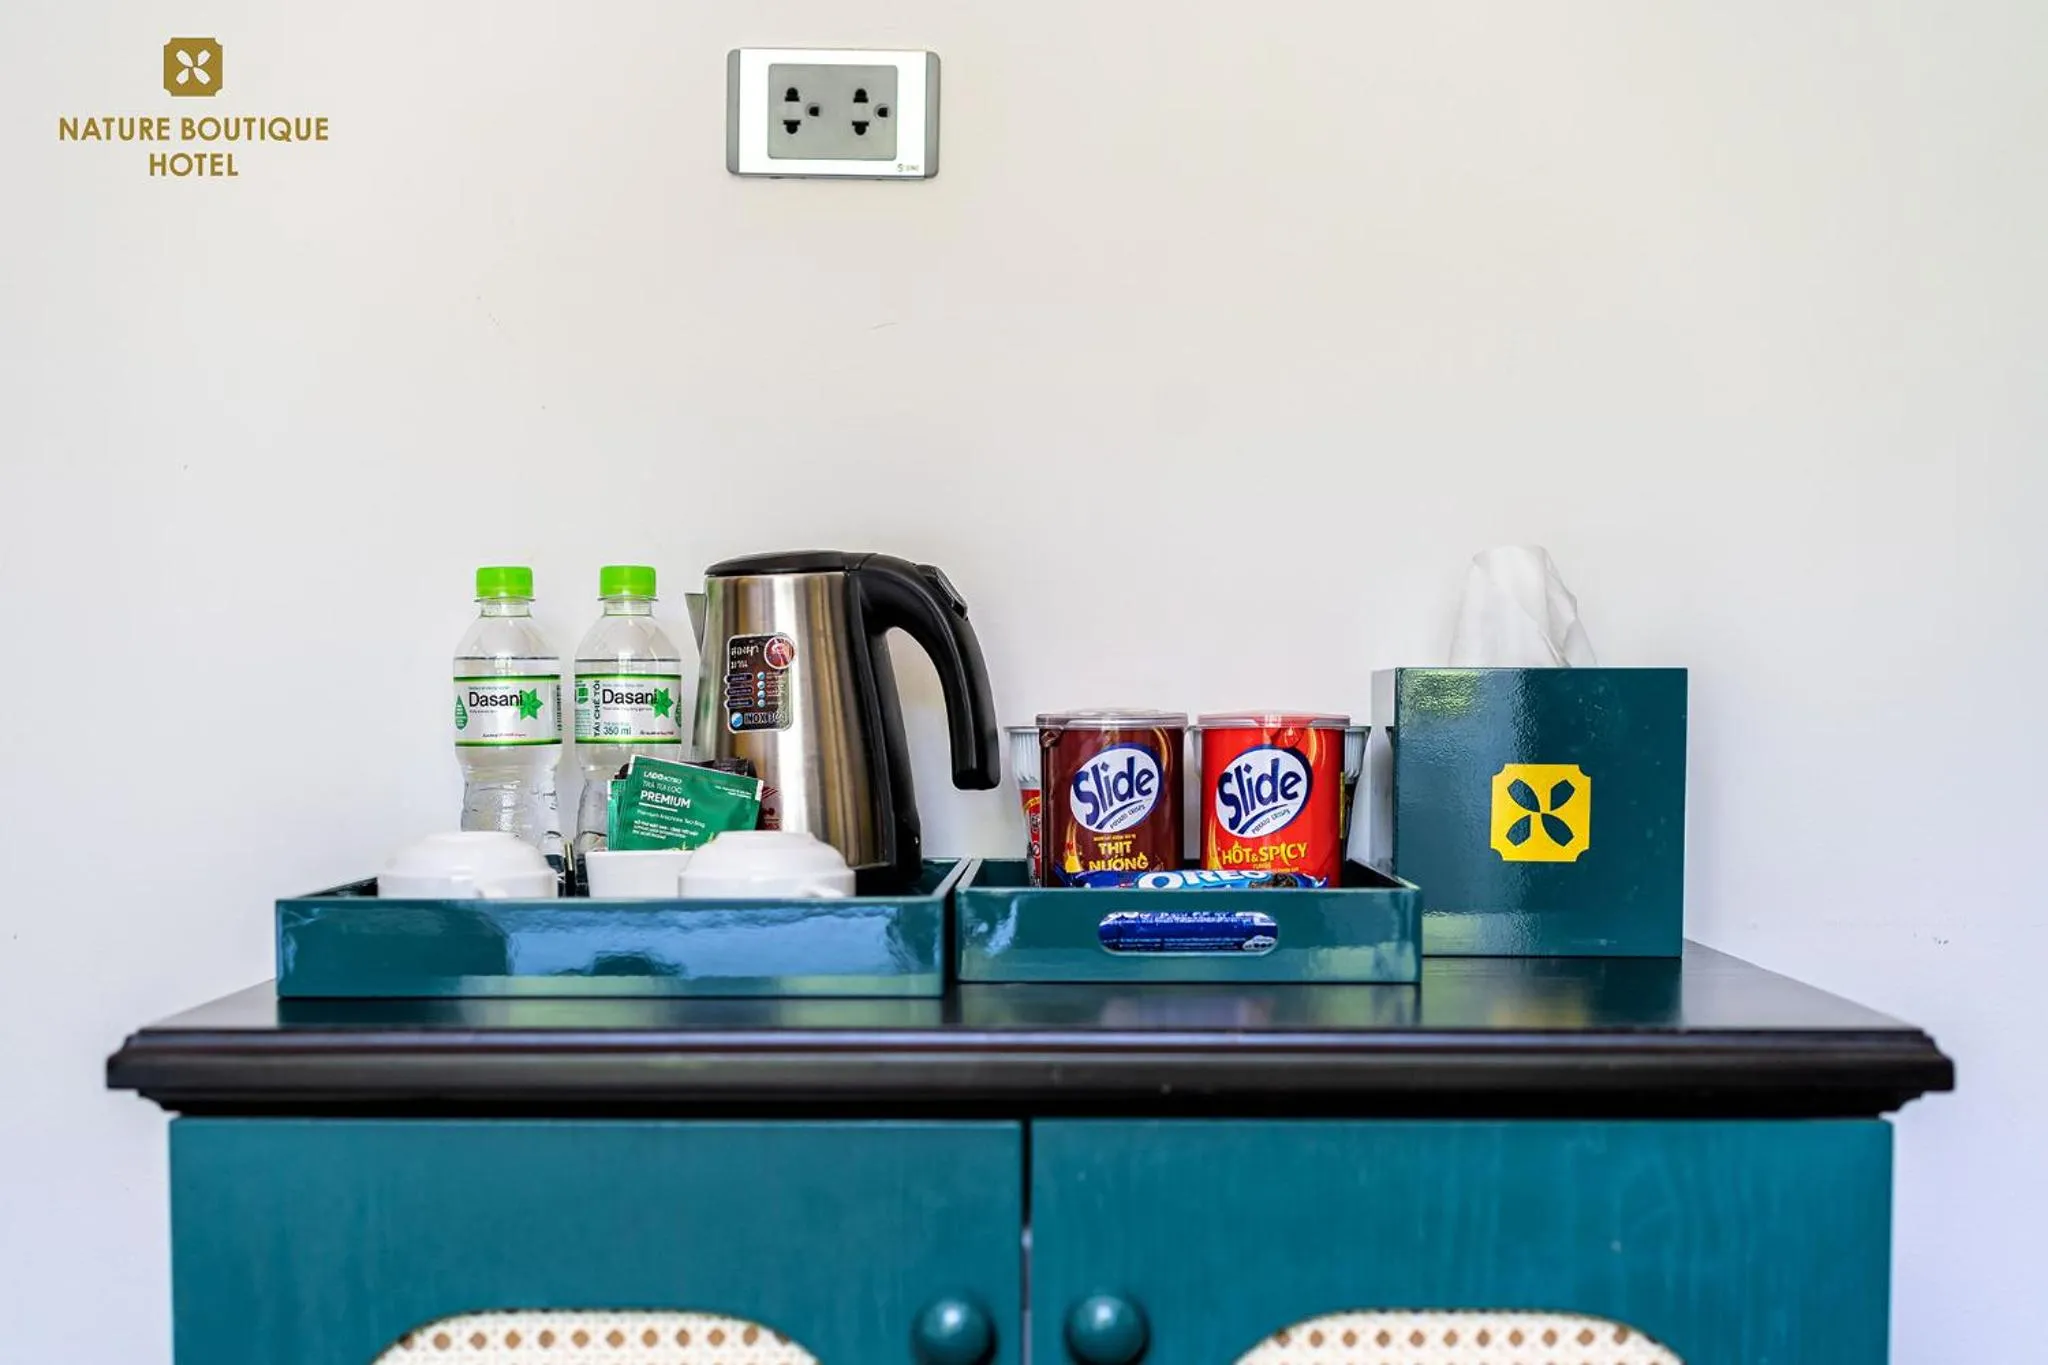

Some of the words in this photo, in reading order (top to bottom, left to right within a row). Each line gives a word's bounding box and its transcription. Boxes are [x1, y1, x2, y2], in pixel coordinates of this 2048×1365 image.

[468, 690, 523, 707] Dasani
[602, 688, 658, 704] Dasani
[603, 726, 619, 735] 350
[640, 790, 692, 809] PREMIUM
[1072, 756, 1155, 826] Slide
[1217, 758, 1302, 831] Slide
